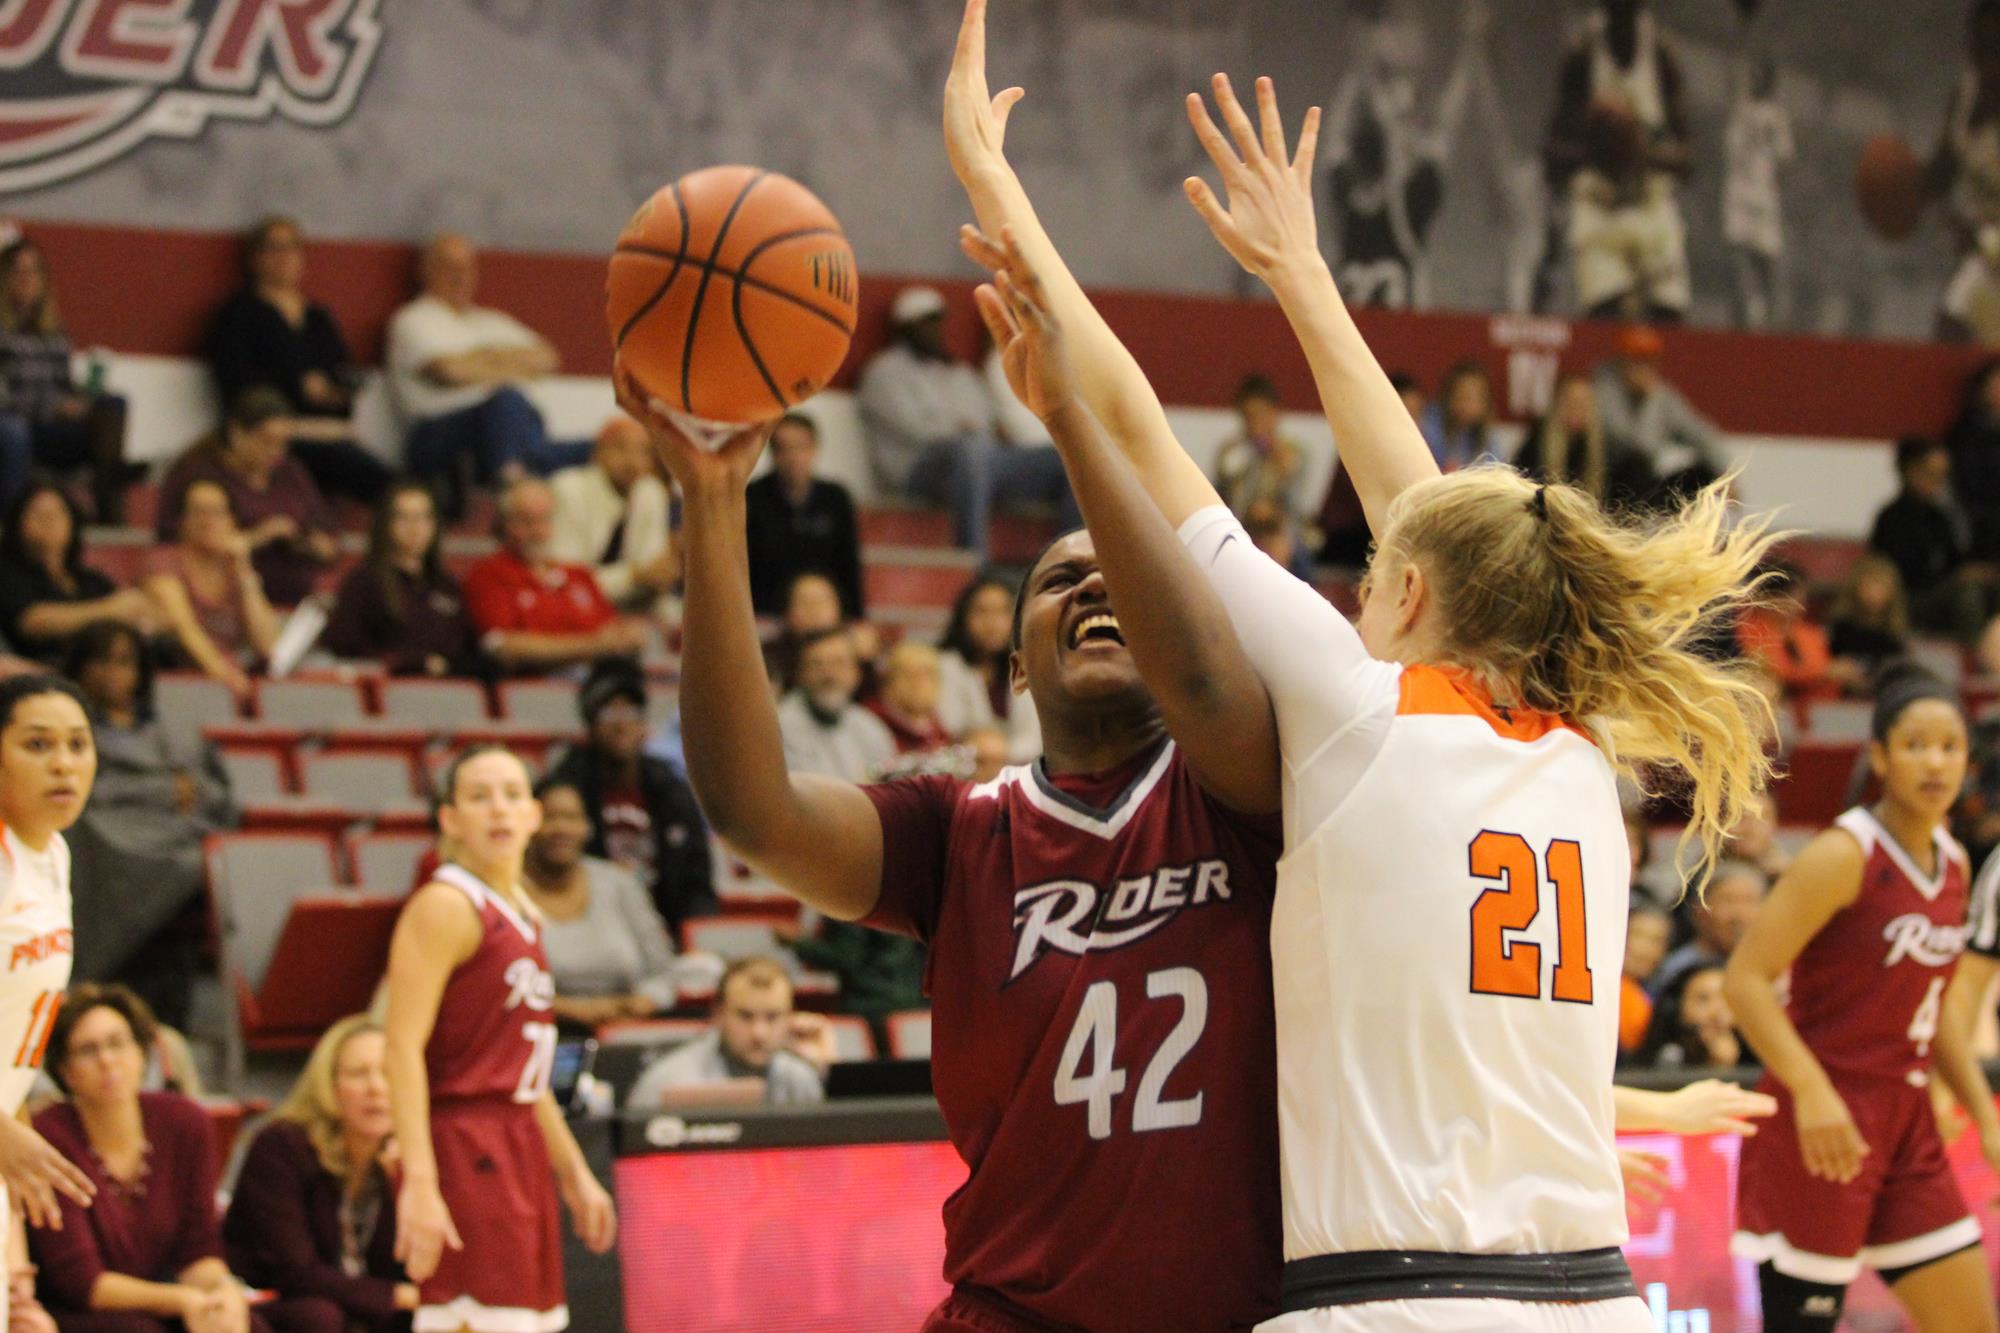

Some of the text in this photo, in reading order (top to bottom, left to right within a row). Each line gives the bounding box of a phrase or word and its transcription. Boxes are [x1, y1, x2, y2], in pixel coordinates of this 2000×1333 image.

[1001, 859, 1232, 979] RDER
[1468, 829, 1593, 1006] 21
[13, 990, 63, 1069] 11
[1053, 966, 1208, 1140] 42
